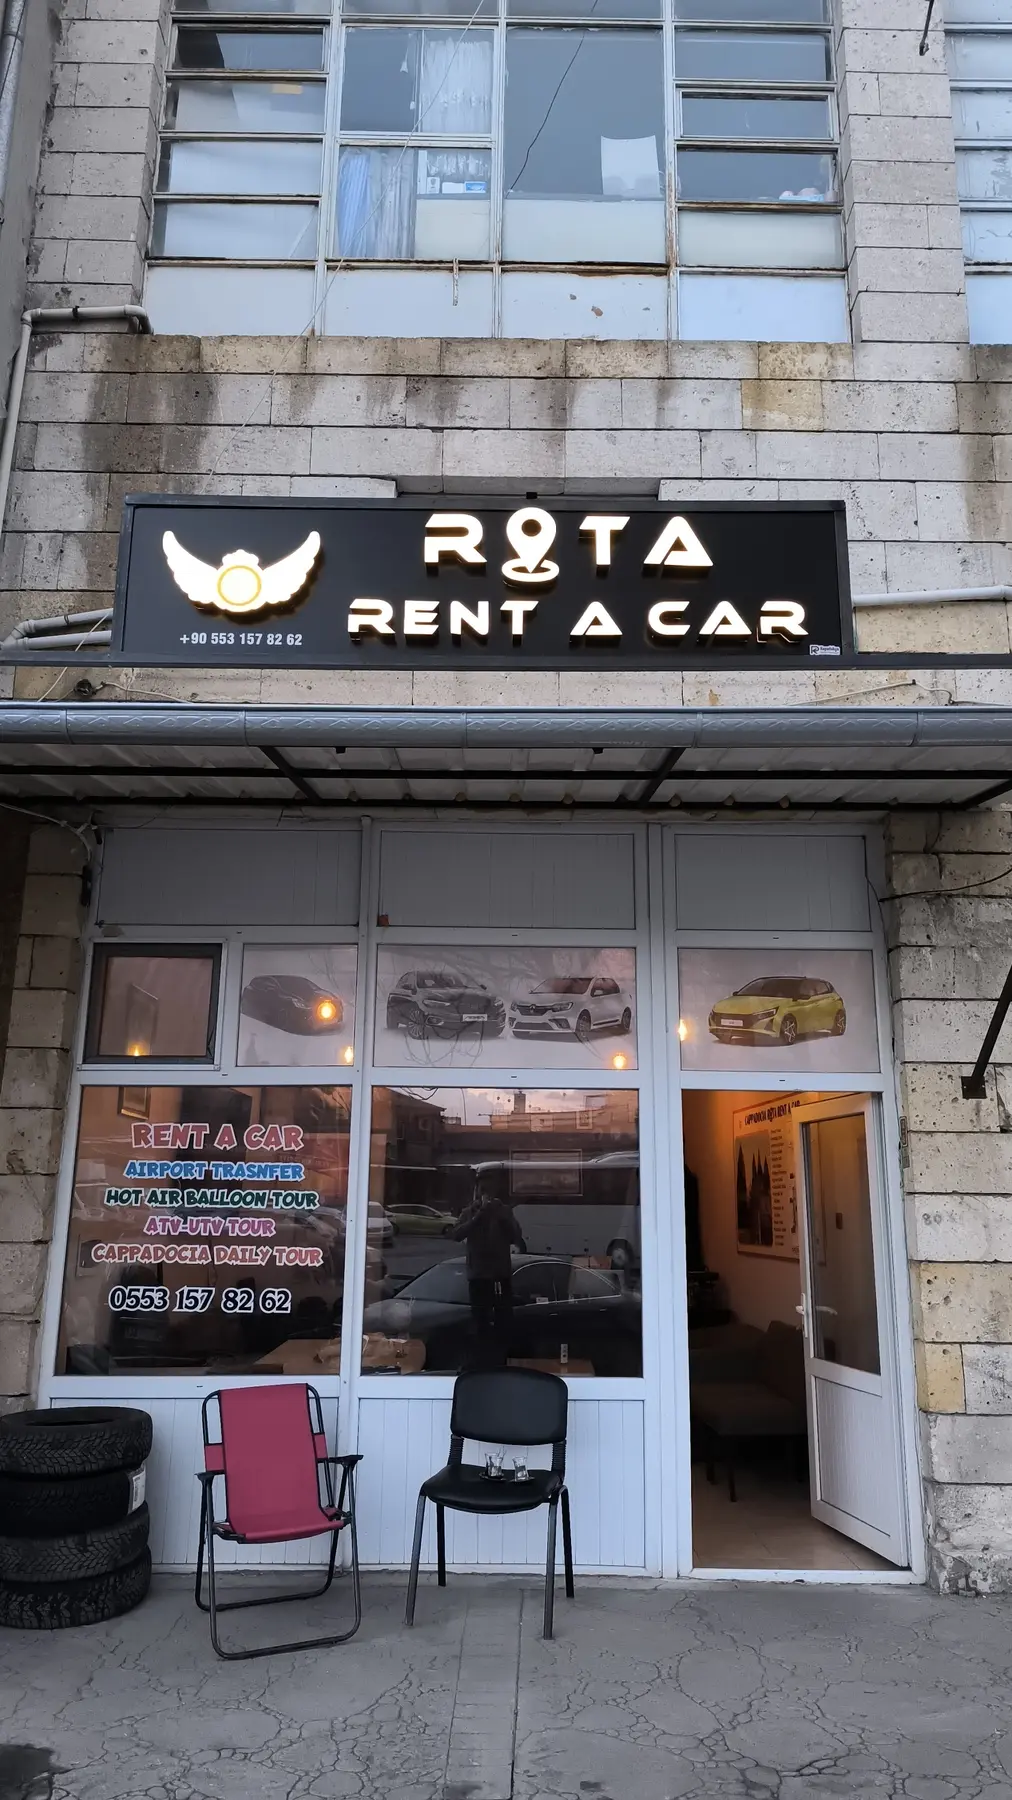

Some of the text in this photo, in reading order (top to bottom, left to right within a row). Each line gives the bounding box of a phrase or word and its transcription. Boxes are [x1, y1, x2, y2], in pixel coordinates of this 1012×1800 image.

[347, 598, 809, 636] RENT A CAR
[179, 633, 303, 646] +90 553 157 82 62
[131, 1123, 305, 1151] RENT A CAR
[124, 1160, 208, 1180] AIRPORT
[210, 1162, 305, 1182] TRASNFER
[104, 1187, 320, 1210] HOT AIR BALLOON TOUR
[143, 1216, 276, 1237] ATV-UTV TOUR
[91, 1243, 324, 1267] CAPPADOCIA DAILY TOUR
[108, 1285, 292, 1314] 0553 157 82 62
